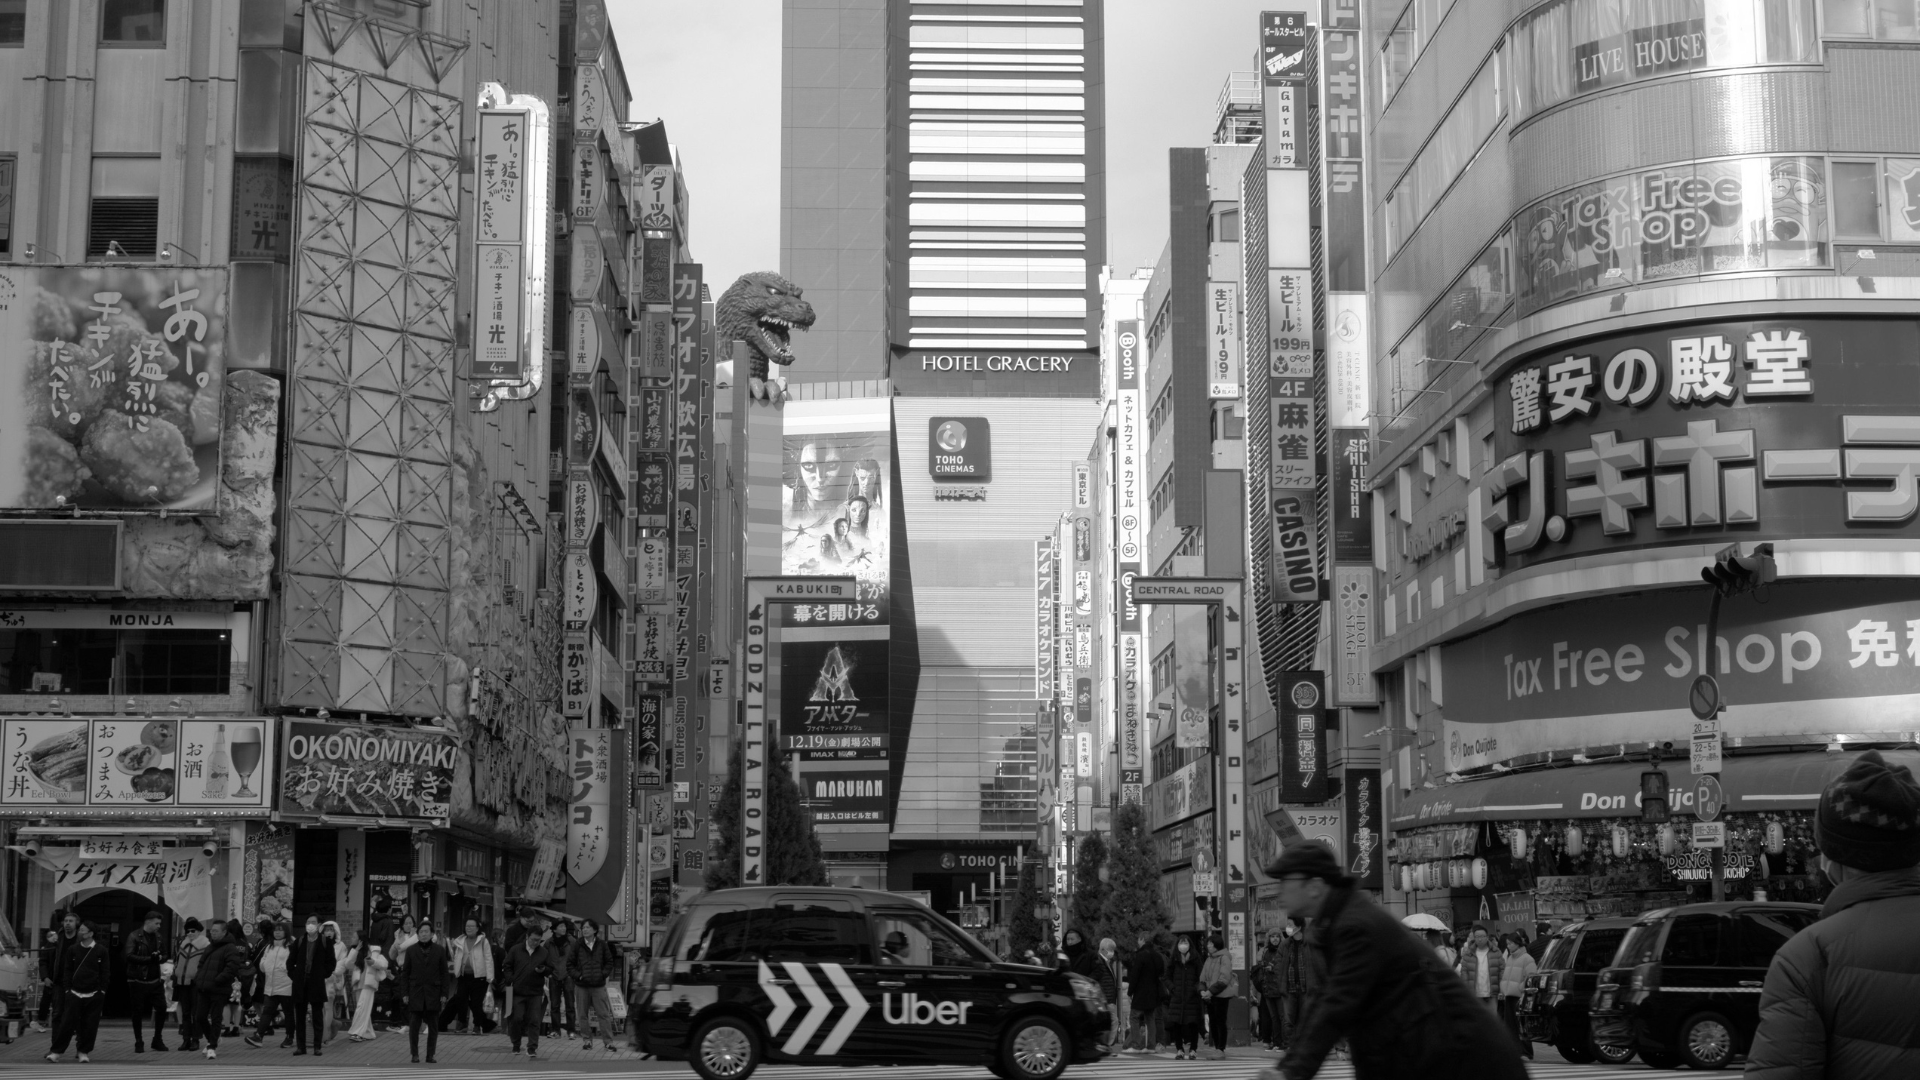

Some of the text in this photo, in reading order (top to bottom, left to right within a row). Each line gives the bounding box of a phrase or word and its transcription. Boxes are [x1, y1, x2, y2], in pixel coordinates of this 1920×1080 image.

[1580, 32, 1706, 83] LIVE HOUSE
[580, 129, 591, 137] 7F
[1280, 90, 1295, 150] Garam
[1272, 155, 1303, 165] ガラム
[575, 205, 594, 216] 6F
[650, 175, 666, 217] ダーツ
[1561, 170, 1744, 229] Tax Free
[1591, 207, 1711, 255] Shop
[1214, 288, 1229, 336] 生ビール
[1279, 275, 1296, 333] 生ビール
[88, 291, 123, 389] チキンが
[488, 324, 506, 344] 光
[1272, 337, 1311, 351] 199円
[489, 361, 504, 374] 4F
[576, 352, 586, 364] 光
[922, 355, 1074, 373] HOTEL GRACERY
[1118, 332, 1137, 380] Booth
[1218, 338, 1229, 381] 199円
[127, 339, 169, 433] 猛烈に
[1279, 380, 1306, 397] 4F
[1509, 329, 1814, 435] 驚安の殿堂
[645, 390, 662, 441] 山内農場
[1124, 395, 1135, 451] ネットカフェ
[587, 433, 593, 450] 3F
[1277, 402, 1310, 461] 麻雀
[935, 455, 964, 465] TOHO
[935, 465, 975, 473] CINEMAS
[1124, 456, 1134, 465] &
[1274, 465, 1305, 474] スリー
[1078, 473, 1087, 505] 東京ビル
[1124, 469, 1135, 508] カプセル
[1274, 476, 1314, 486] ファイブ
[1349, 439, 1360, 518] SHISHA
[573, 482, 586, 539] お好み焼き
[645, 516, 659, 526] 4F
[676, 547, 692, 565] 薬
[1273, 496, 1317, 594] CASINO
[1038, 547, 1052, 591] 747
[644, 590, 658, 600] 3F
[1138, 586, 1225, 595] CENTRAL ROAD
[109, 614, 174, 626] MONJA
[568, 620, 582, 629] 1F
[674, 574, 692, 680] マツモトキヨシ
[793, 604, 879, 622] 幕を開ける
[566, 643, 584, 651] 新宿
[1038, 596, 1052, 694] カラオケランド
[1345, 614, 1356, 659] STAGE
[1356, 614, 1367, 652] IDOL
[566, 651, 584, 697] かっぱ
[637, 661, 664, 673] 大阪家
[1124, 646, 1138, 691] カラオケ
[1504, 618, 1920, 701] Tax Free Shop 免
[1346, 672, 1367, 686] 5F
[567, 700, 581, 710] B1
[674, 696, 687, 725] Shop
[674, 725, 686, 749] Free
[745, 625, 763, 858] GODZILLA ROAD
[1124, 703, 1138, 766] まねきねこ
[1225, 646, 1242, 841] ゴジラロード
[1462, 735, 1498, 759] Don Quijote
[7, 726, 31, 798] うな丼
[94, 724, 116, 800] おつまみ
[183, 742, 203, 779] お酒
[289, 734, 459, 770] OKONOMIYAKI
[595, 732, 608, 784] 大衆酒場
[674, 751, 686, 770] Tax
[810, 750, 834, 758] IMAX
[296, 764, 440, 801] お好み焼き
[572, 738, 594, 826] トラノコ
[816, 780, 883, 798] MARUHAN
[1037, 729, 1054, 822] マルハン
[1125, 772, 1139, 782] 2F
[1700, 778, 1713, 786] 7-20
[118, 789, 166, 800] Appetizers
[201, 790, 222, 799] Sake
[1580, 791, 1627, 811] Don
[1697, 786, 1709, 815] P
[1705, 801, 1716, 815] 40
[1297, 815, 1340, 827] カラオケ
[84, 840, 161, 856] お好み食堂
[958, 855, 995, 867] TOHO
[881, 992, 974, 1026] Uber
